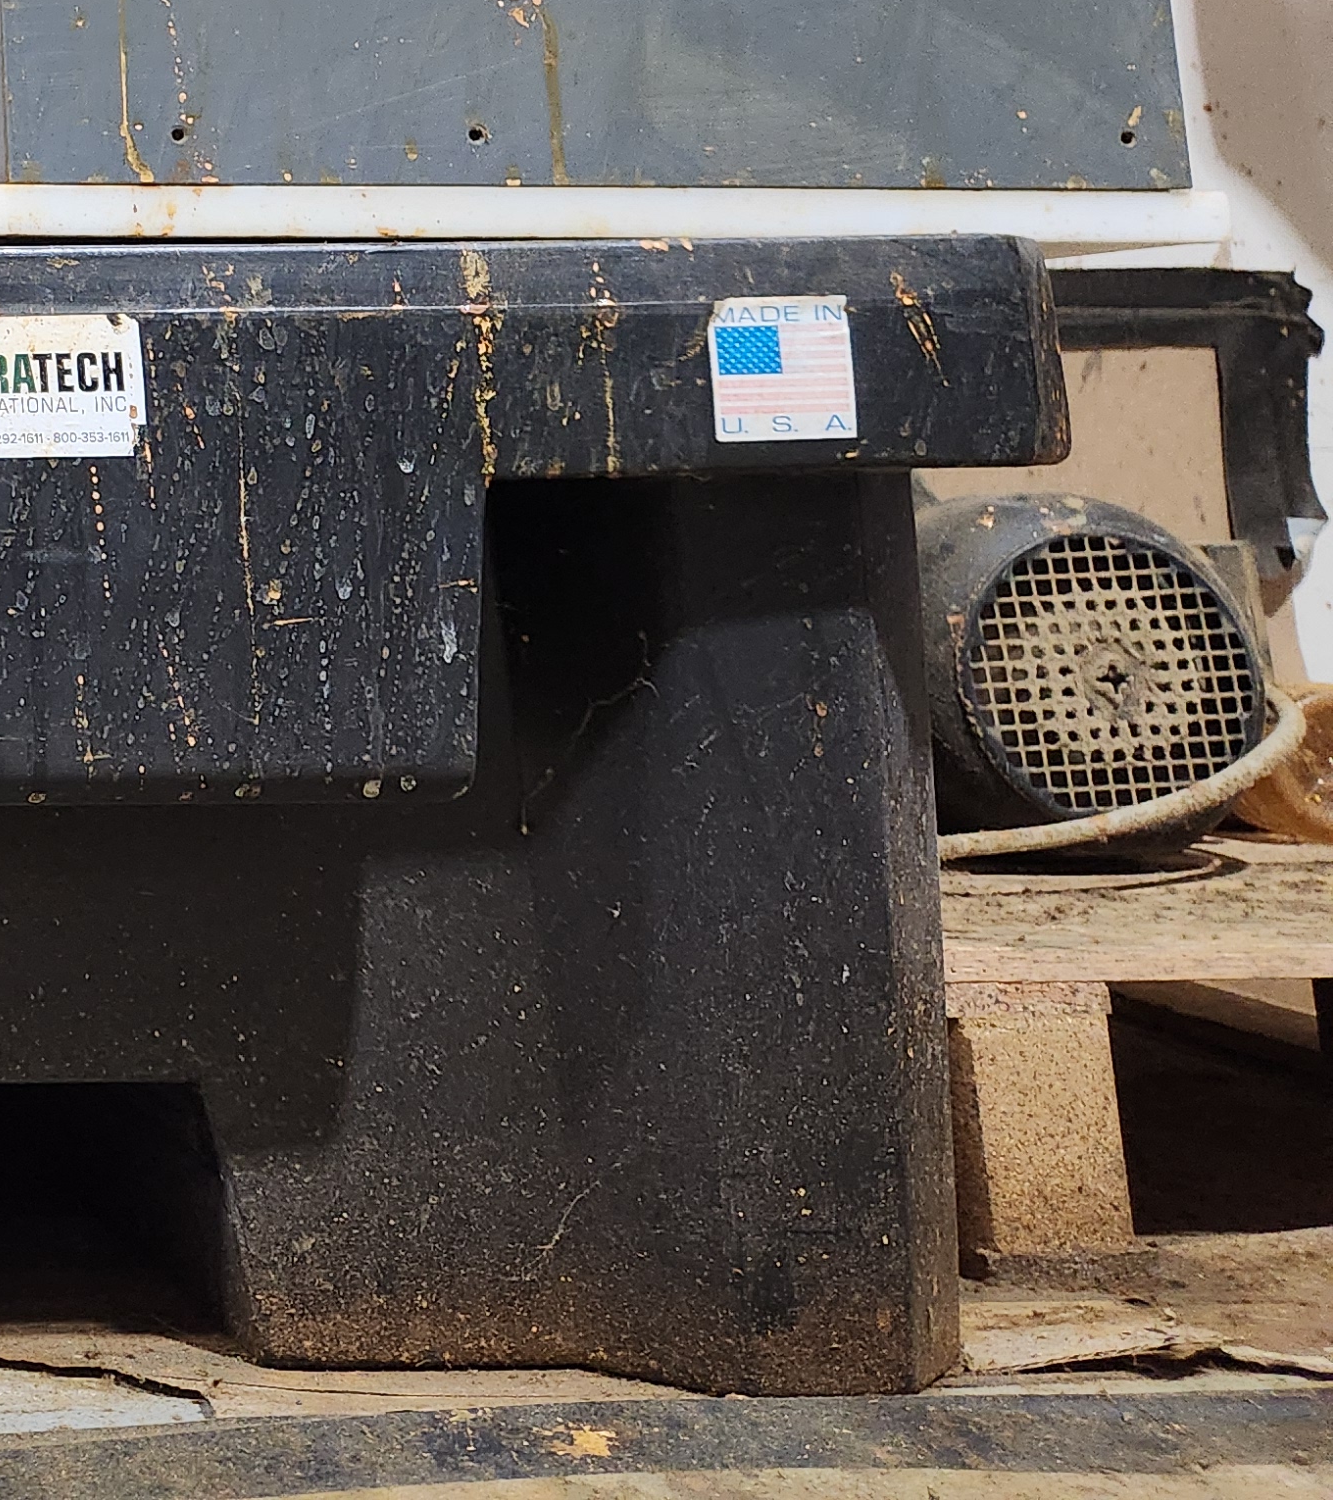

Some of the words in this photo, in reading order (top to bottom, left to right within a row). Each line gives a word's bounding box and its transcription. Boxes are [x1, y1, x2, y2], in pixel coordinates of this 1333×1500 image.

[712, 305, 800, 324] MADE
[814, 304, 842, 321] IN
[53, 431, 130, 444] 800-353-1611
